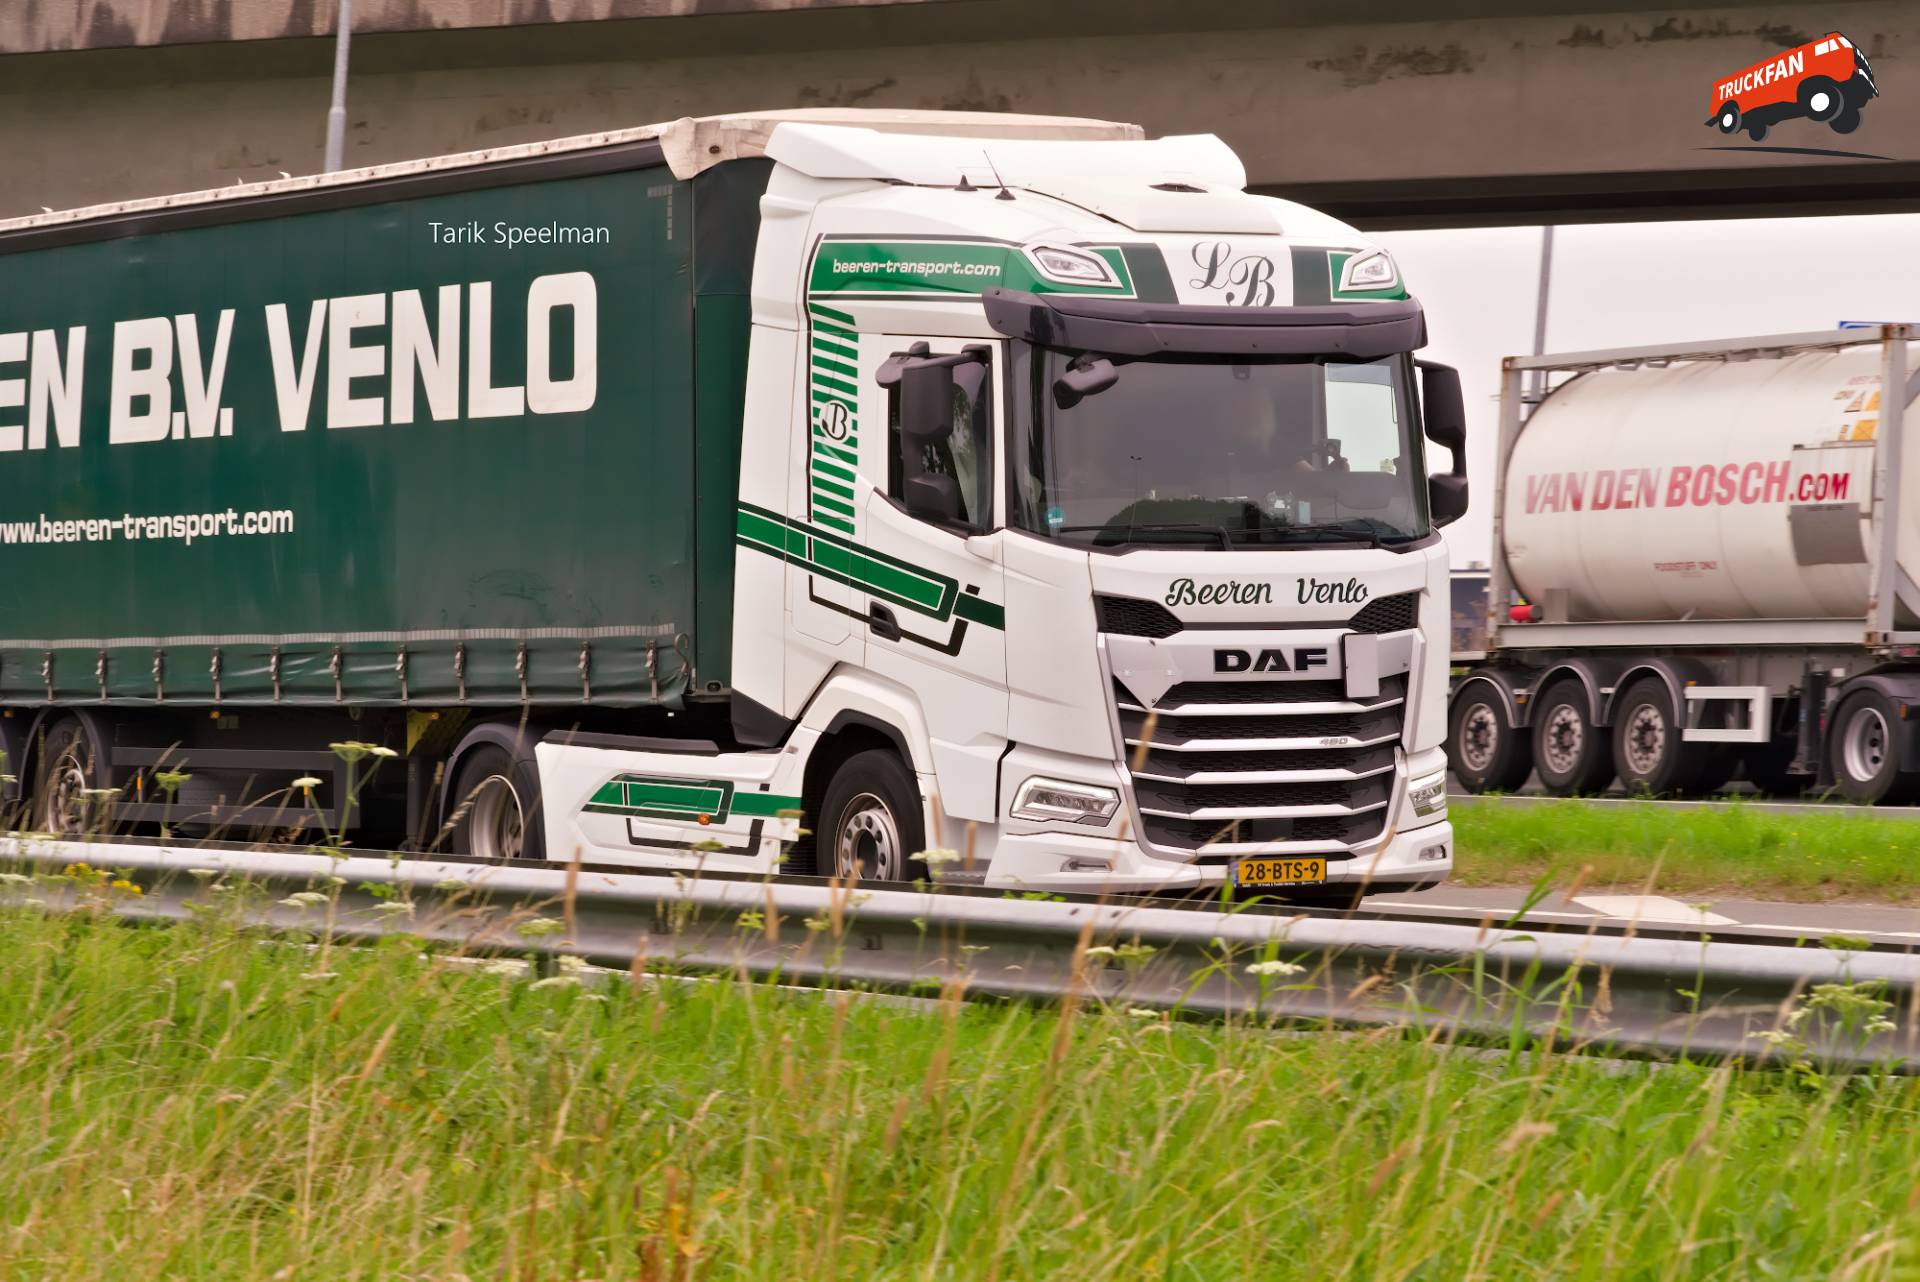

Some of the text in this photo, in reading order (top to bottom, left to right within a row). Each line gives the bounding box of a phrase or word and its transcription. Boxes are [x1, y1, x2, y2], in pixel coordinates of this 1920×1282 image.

[832, 259, 1001, 277] beeren-transport.com
[109, 308, 236, 445] B.V.
[265, 271, 598, 432] VENLO
[821, 402, 848, 441] B
[1524, 471, 1588, 514] VAN
[1591, 467, 1662, 511] DEN
[0, 508, 293, 546] ww.beeren-transport.com
[1165, 577, 1368, 606] Beeren Venlo
[1213, 648, 1328, 674] DAF
[1245, 861, 1319, 881] 28-BTS-9
